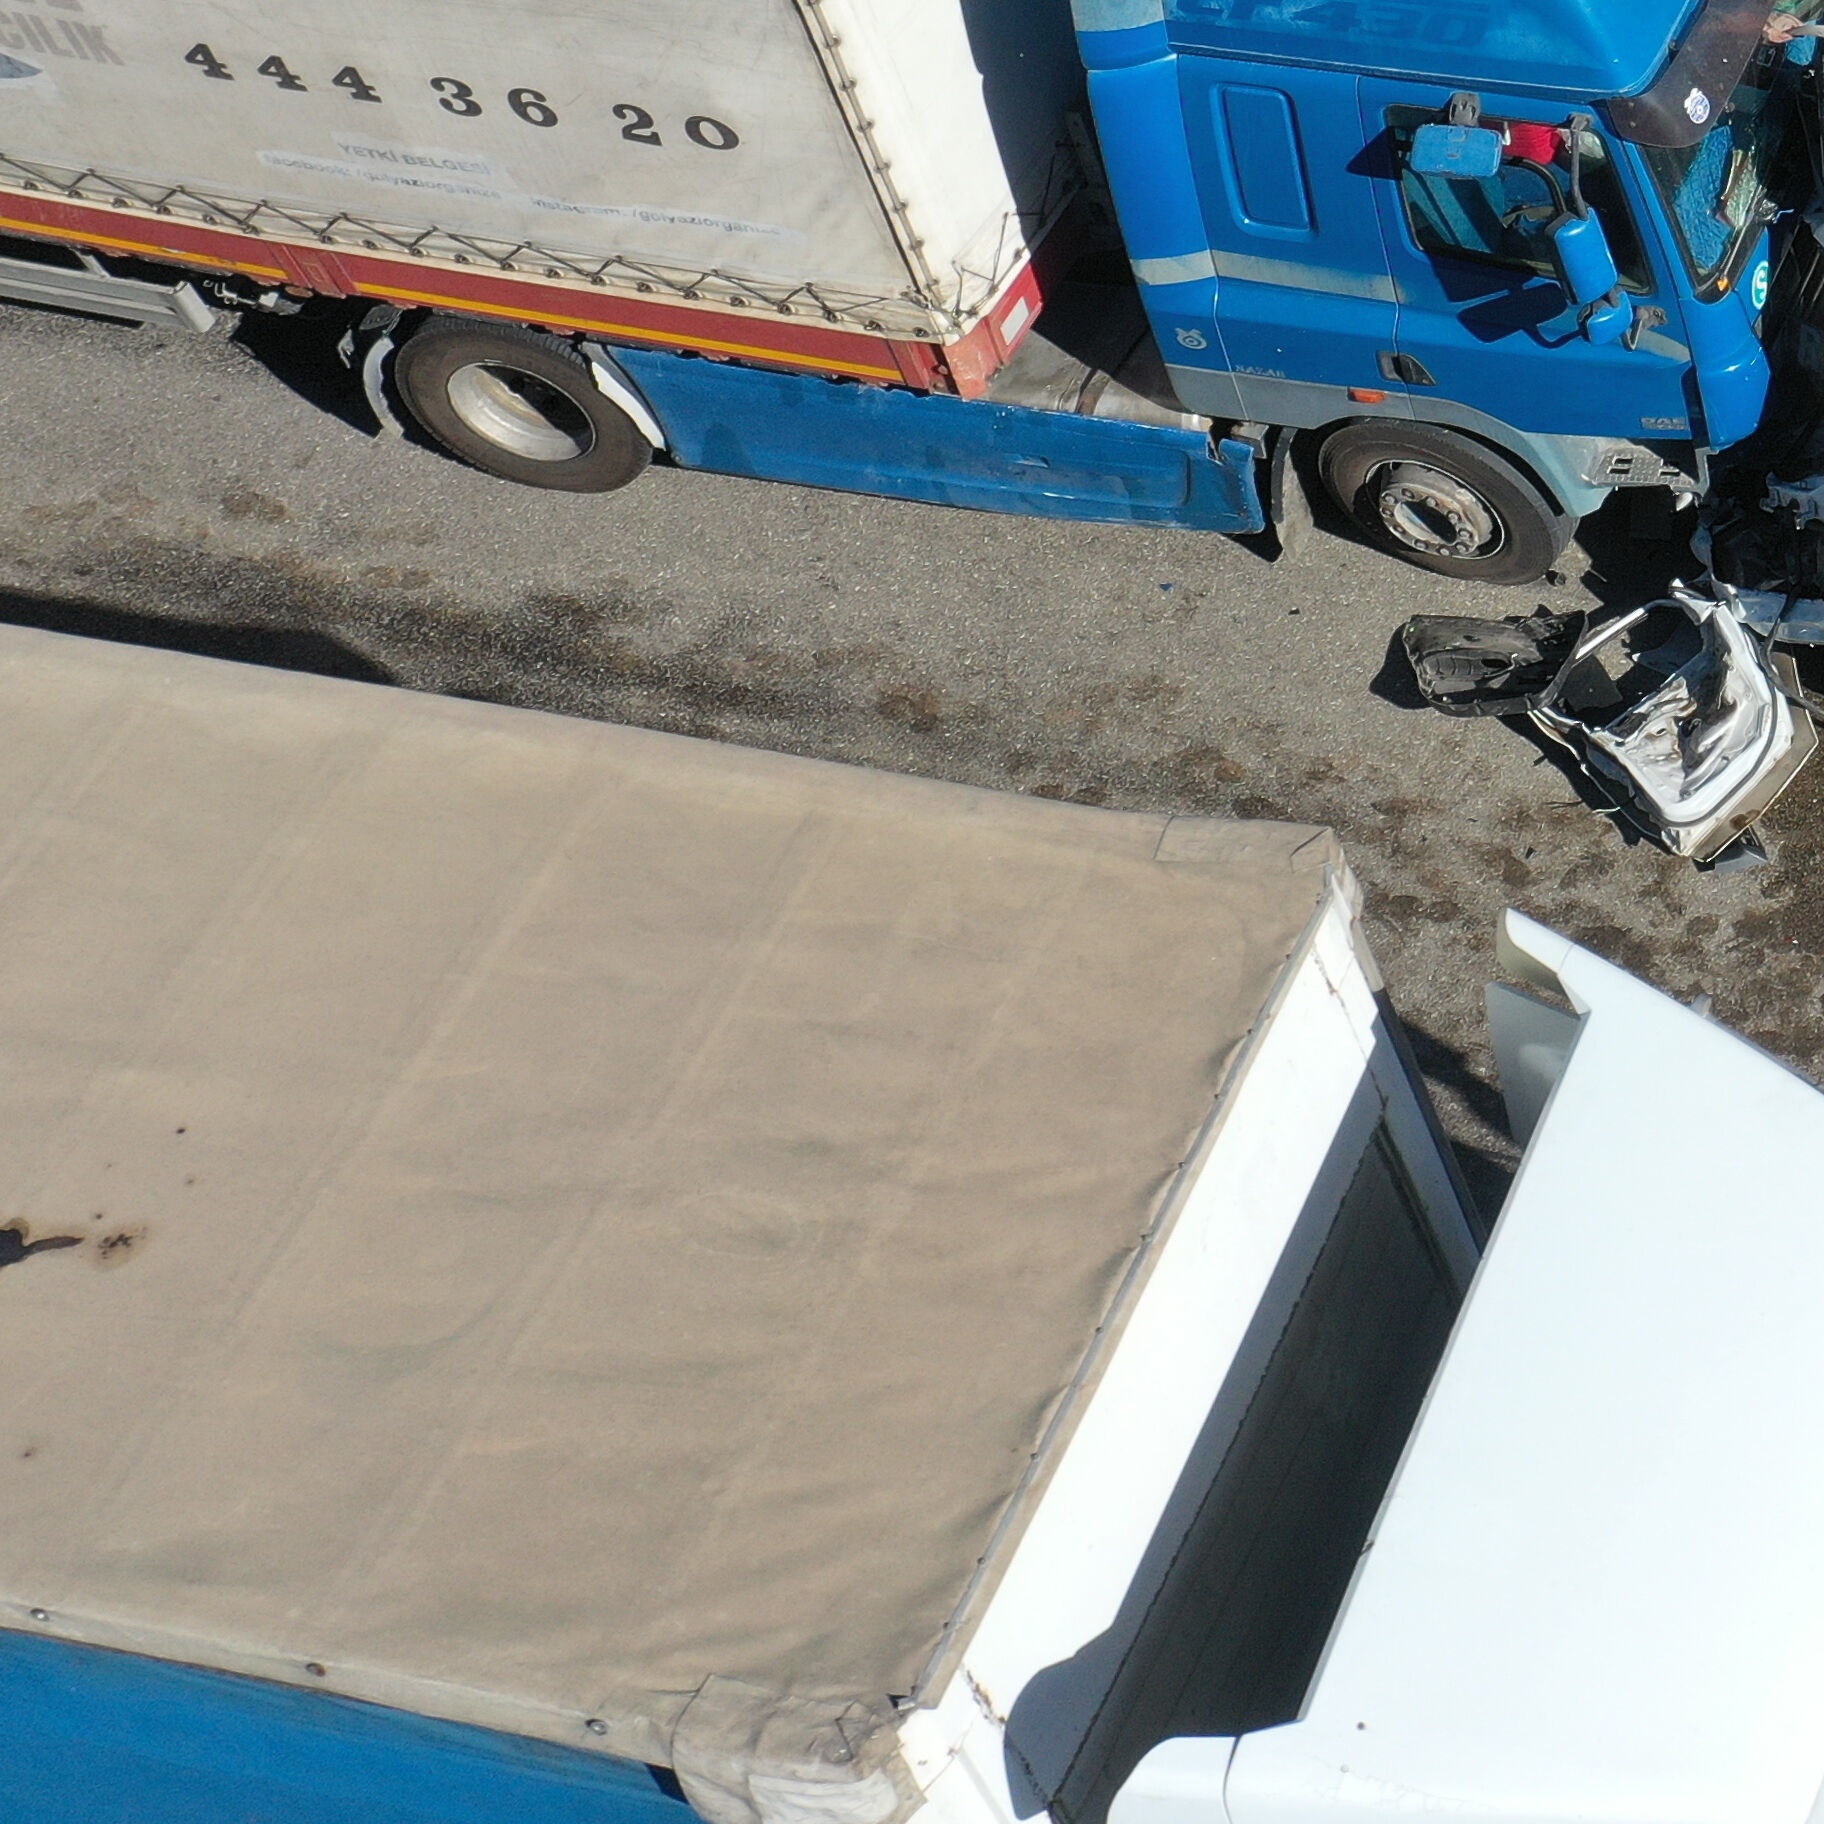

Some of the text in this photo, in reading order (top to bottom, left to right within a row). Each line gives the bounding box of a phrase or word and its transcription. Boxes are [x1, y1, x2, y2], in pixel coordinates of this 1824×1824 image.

[184, 43, 741, 151] 444 36 20
